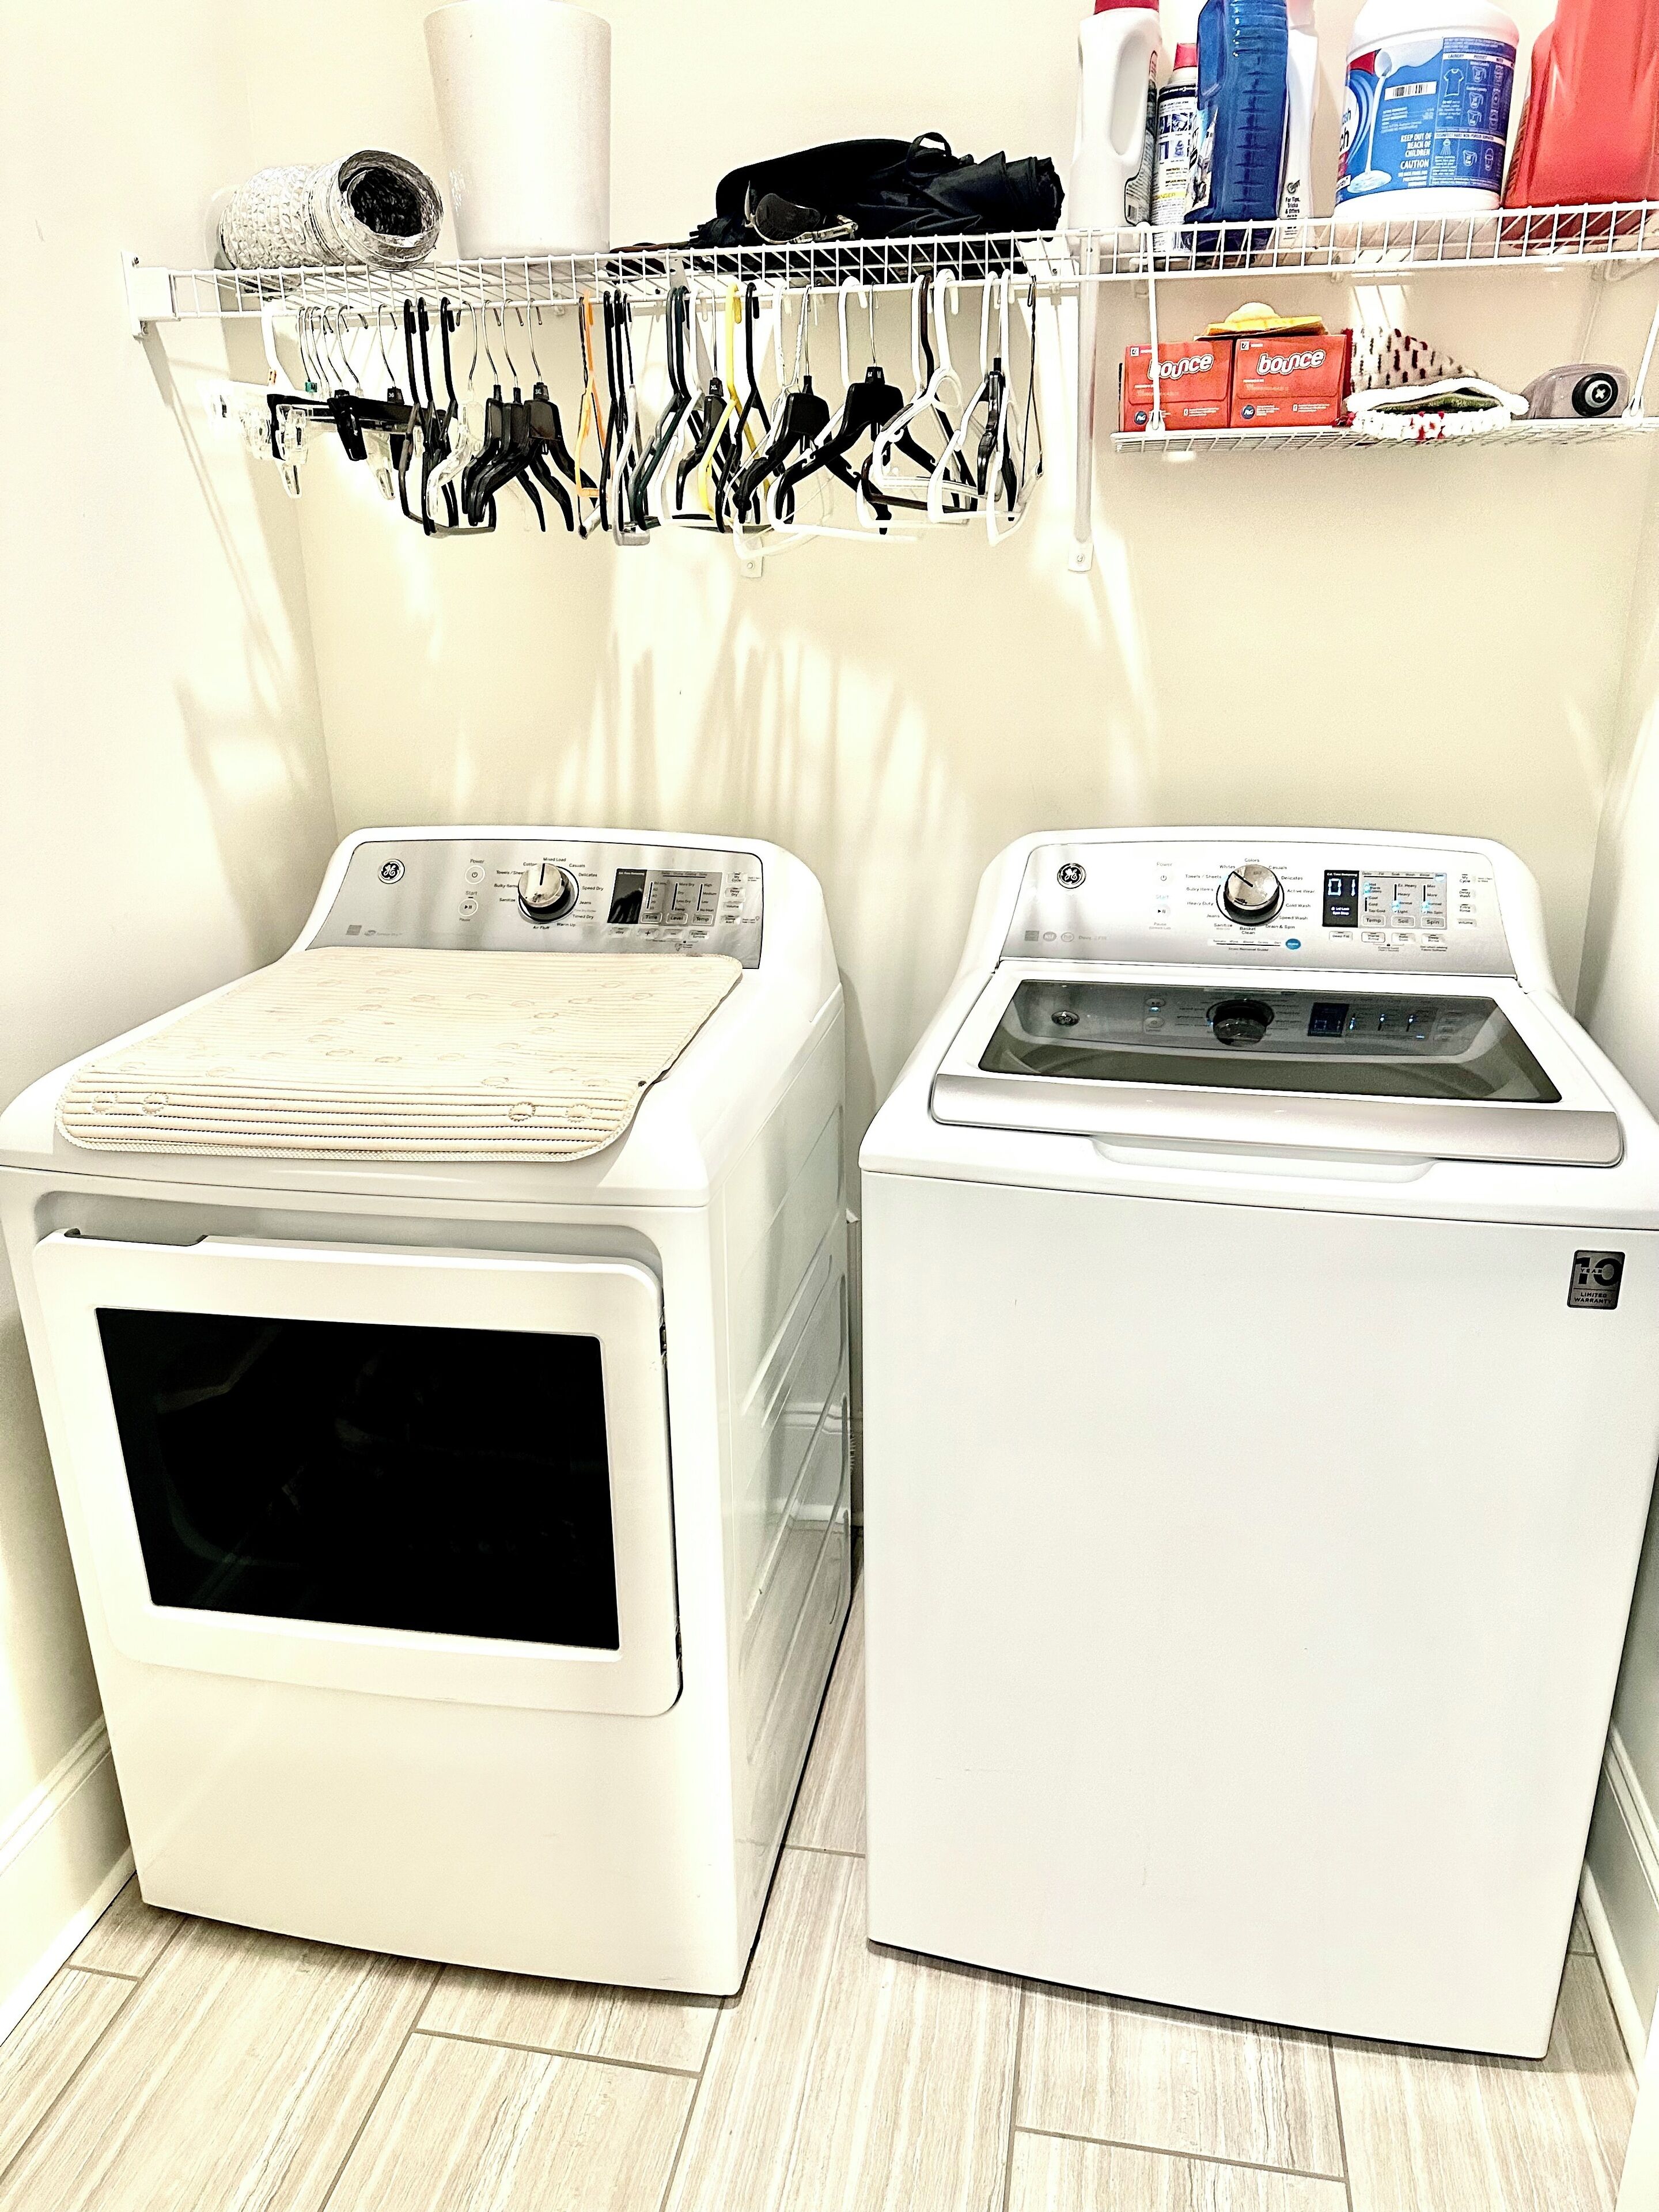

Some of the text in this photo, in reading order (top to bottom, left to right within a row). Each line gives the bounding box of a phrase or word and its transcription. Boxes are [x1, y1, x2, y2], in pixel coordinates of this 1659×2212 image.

[1400, 133, 1414, 143] KEEP
[1406, 149, 1430, 157] CHILDREN
[1400, 159, 1429, 169] CAUTION
[1258, 350, 1325, 375] bounce
[1327, 878, 1356, 896] 01
[1575, 1257, 1622, 1286] 10
